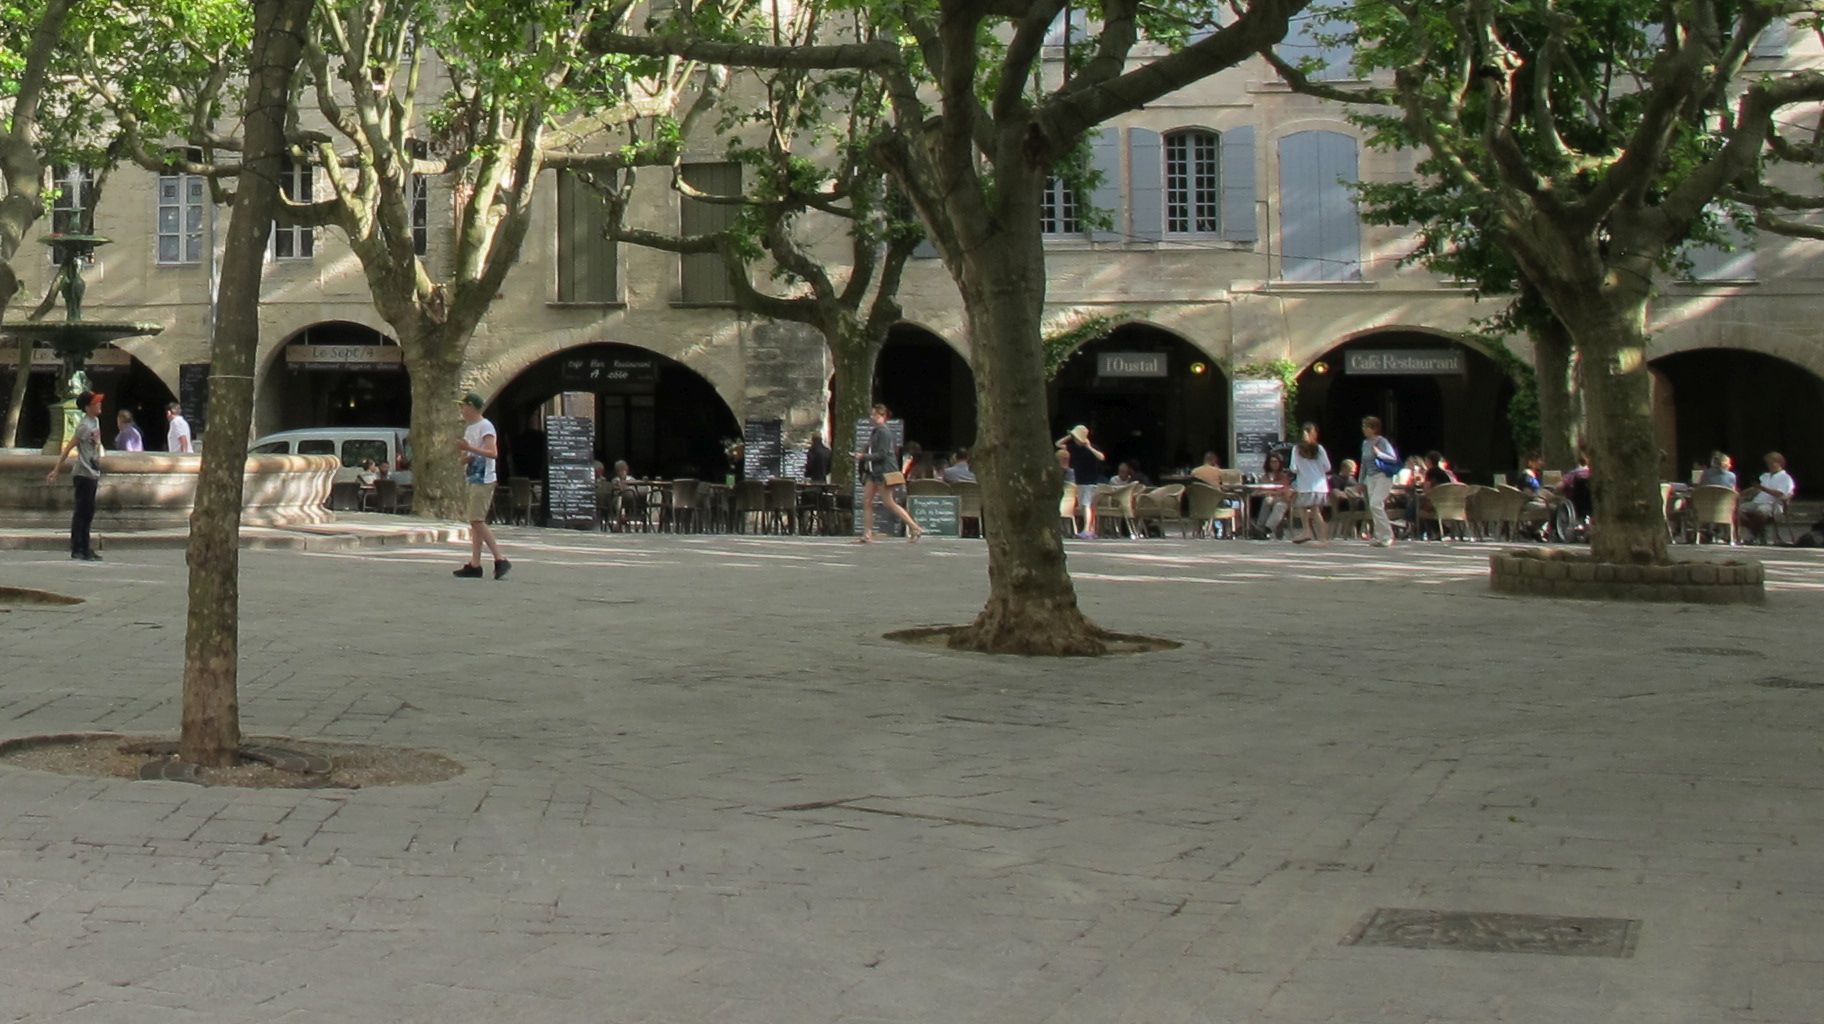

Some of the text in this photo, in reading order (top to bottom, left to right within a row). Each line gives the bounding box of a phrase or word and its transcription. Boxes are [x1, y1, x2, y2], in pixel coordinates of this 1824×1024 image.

[313, 346, 327, 358] Le
[1351, 354, 1458, 370] Café Restaurant
